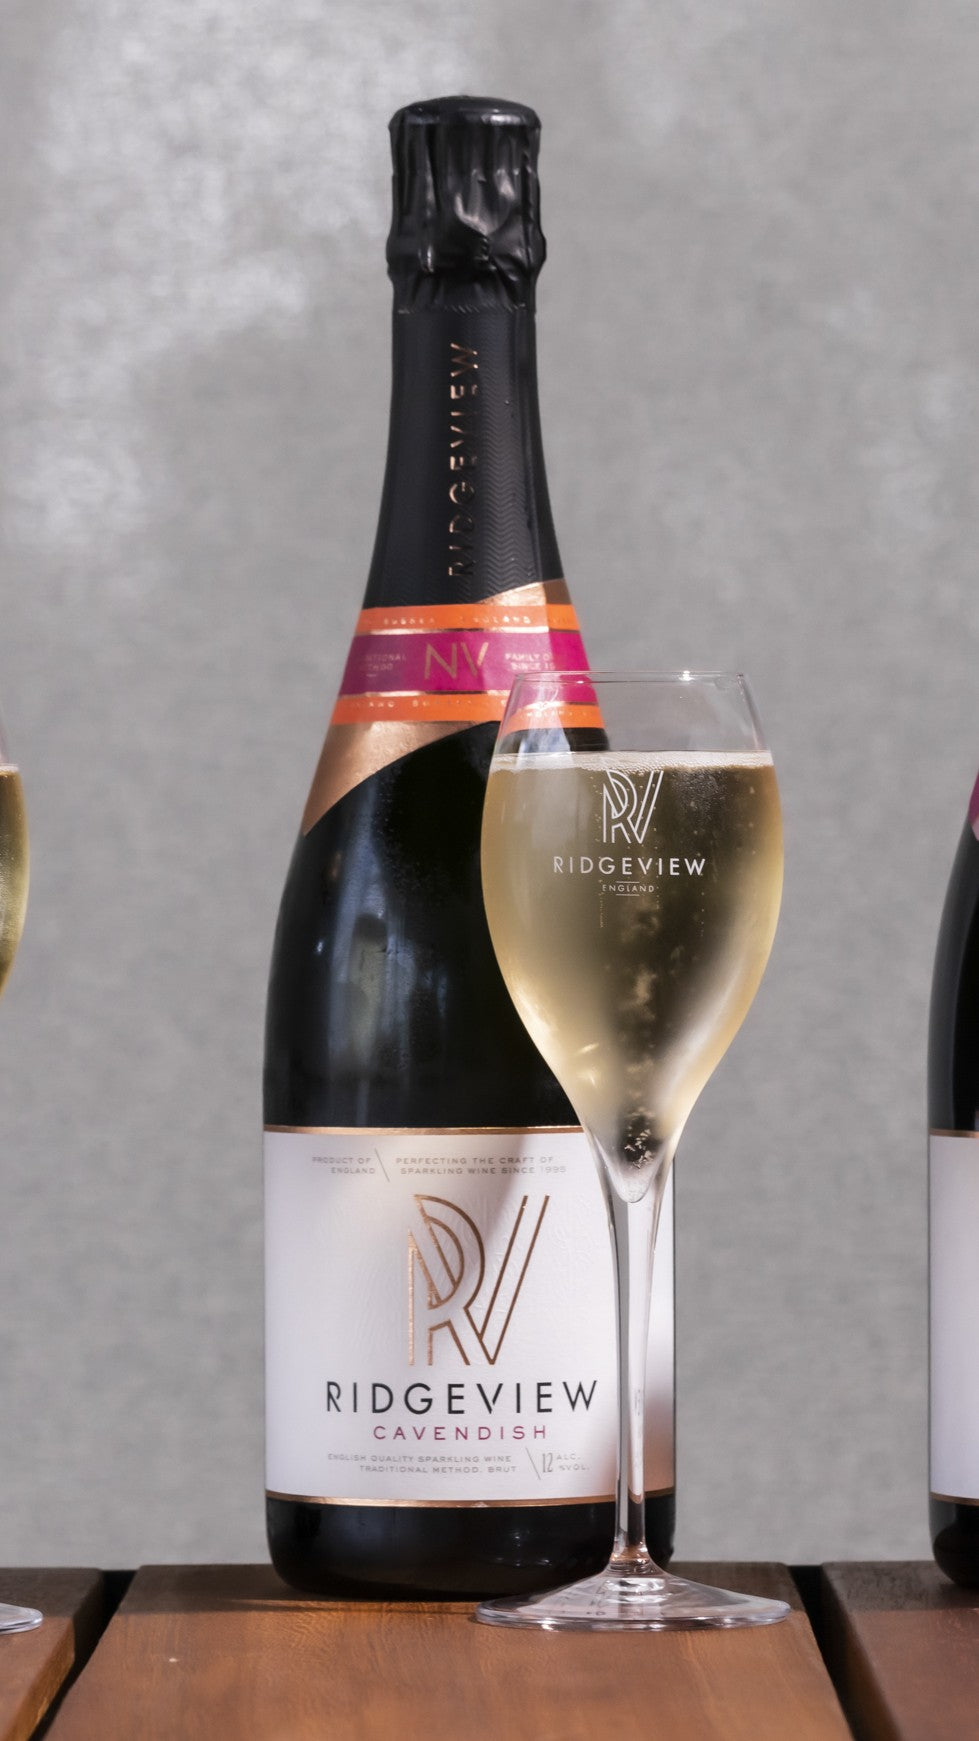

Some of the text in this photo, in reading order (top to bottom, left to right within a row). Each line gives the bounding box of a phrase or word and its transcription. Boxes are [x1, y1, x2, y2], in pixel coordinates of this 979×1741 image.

[448, 342, 479, 577] RIDGEVIEW
[424, 642, 489, 680] NV
[553, 856, 706, 876] RIDGEVIEW
[602, 884, 655, 893] ENGLAND
[312, 1156, 372, 1165] PRODUCT OF
[396, 1155, 554, 1165] PERFECTING THE CRAFT OF
[331, 1166, 376, 1175] ENGLAND
[400, 1165, 567, 1175] SPARKLING WINE SINCE 1995
[407, 1193, 551, 1366] RV
[326, 1380, 597, 1415] RIDGEVIEW
[373, 1425, 546, 1441] CAVENDISH
[327, 1453, 512, 1463] ENGLISH QUALITY SPARKLING WINE
[542, 1452, 553, 1474] 12
[359, 1465, 428, 1474] TRADITIONAL
[487, 1465, 517, 1473] BRUT
